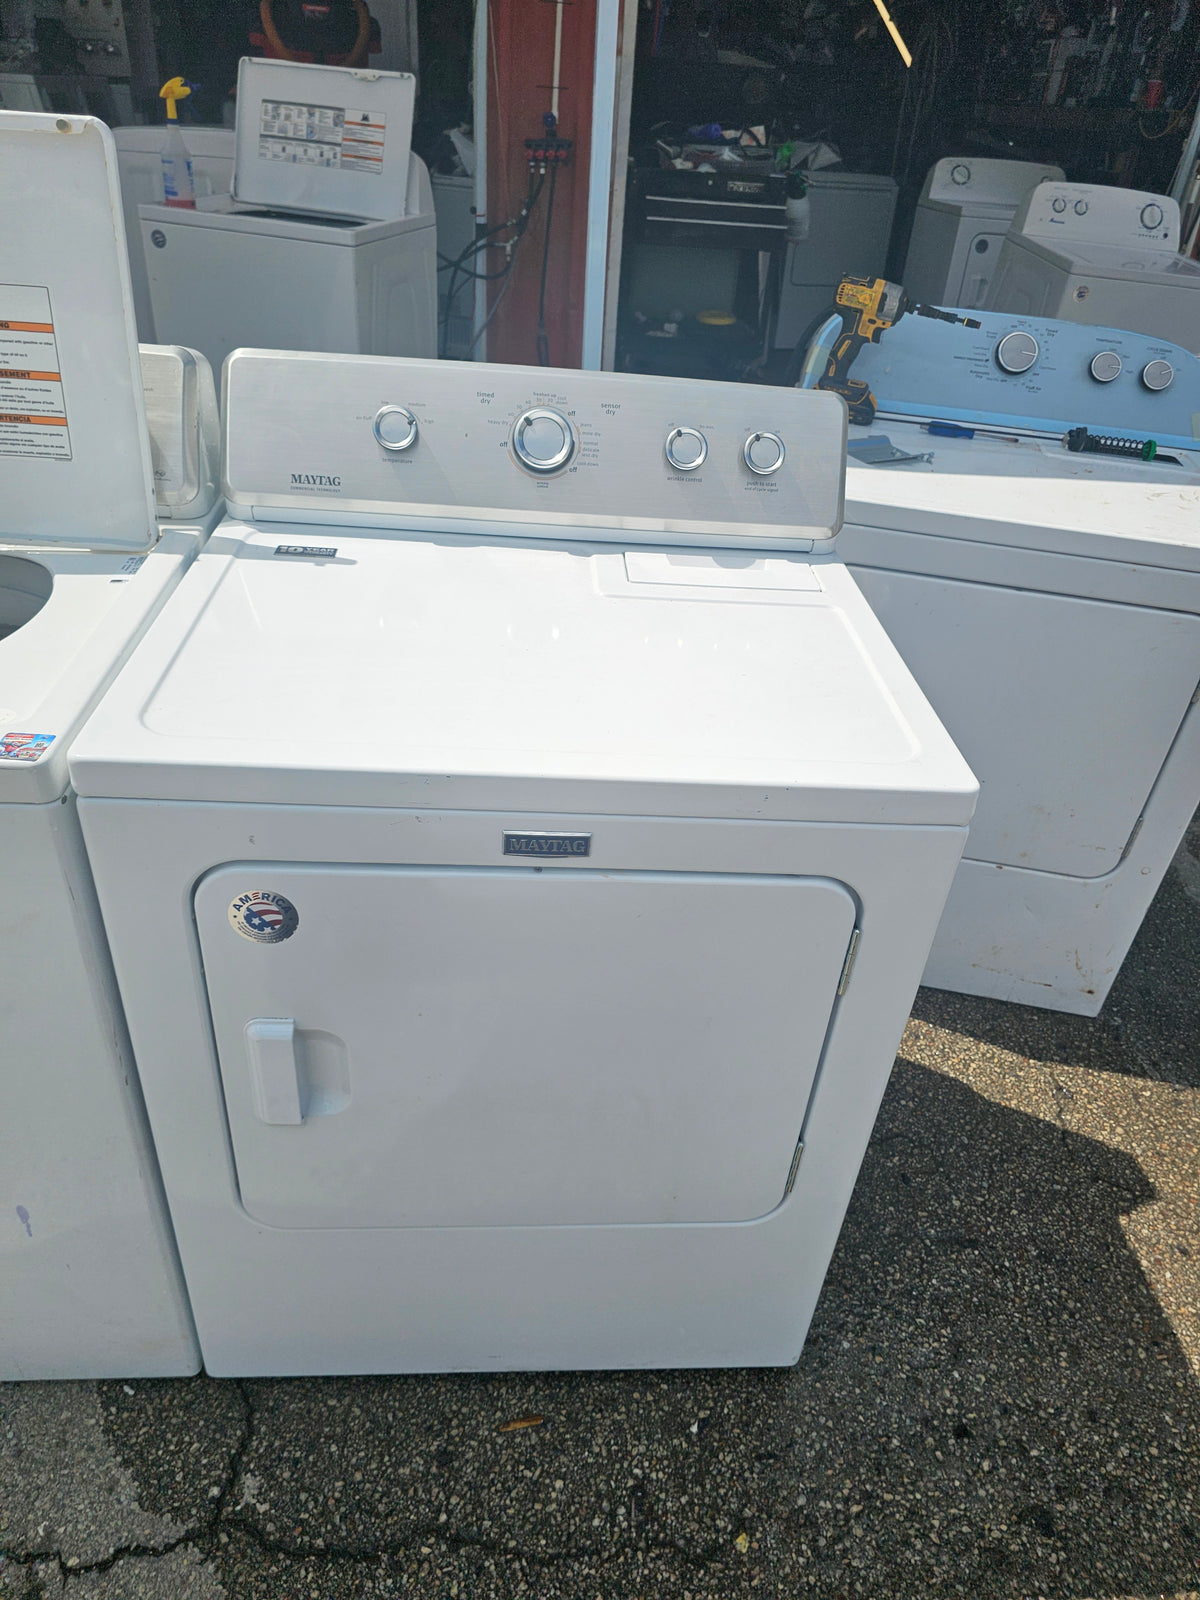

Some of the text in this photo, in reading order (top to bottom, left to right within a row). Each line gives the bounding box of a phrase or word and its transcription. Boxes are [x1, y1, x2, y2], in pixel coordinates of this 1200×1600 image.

[290, 474, 341, 486] MAYTAG
[509, 838, 585, 852] MAYTAG
[232, 892, 292, 914] AMERICA
